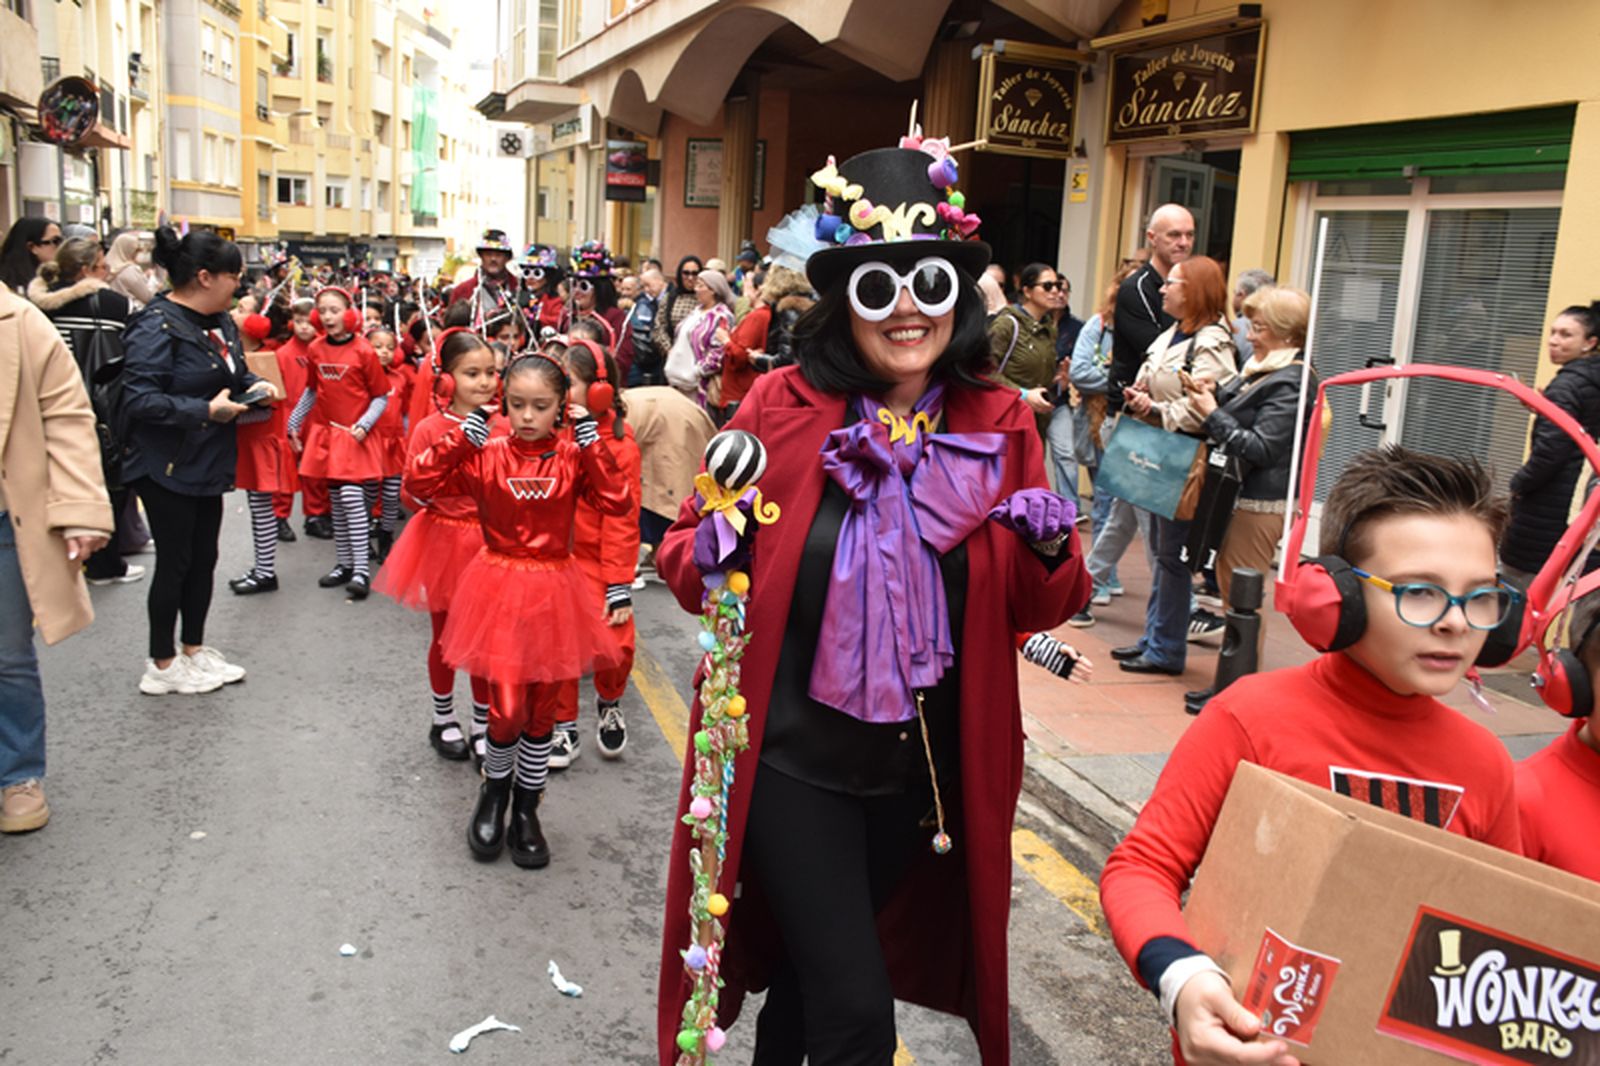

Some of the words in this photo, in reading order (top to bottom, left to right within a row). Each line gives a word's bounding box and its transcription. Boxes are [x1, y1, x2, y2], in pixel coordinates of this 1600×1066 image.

[992, 73, 1022, 101] Taller
[1025, 67, 1040, 78] de
[1133, 56, 1168, 87] Taller
[1171, 48, 1187, 64] de
[994, 103, 1067, 137] Sánchez
[1119, 82, 1242, 127] Sánchez
[1273, 963, 1311, 1036] WONKA
[1429, 949, 1600, 1031] WONKA
[1499, 1021, 1573, 1058] BAR
